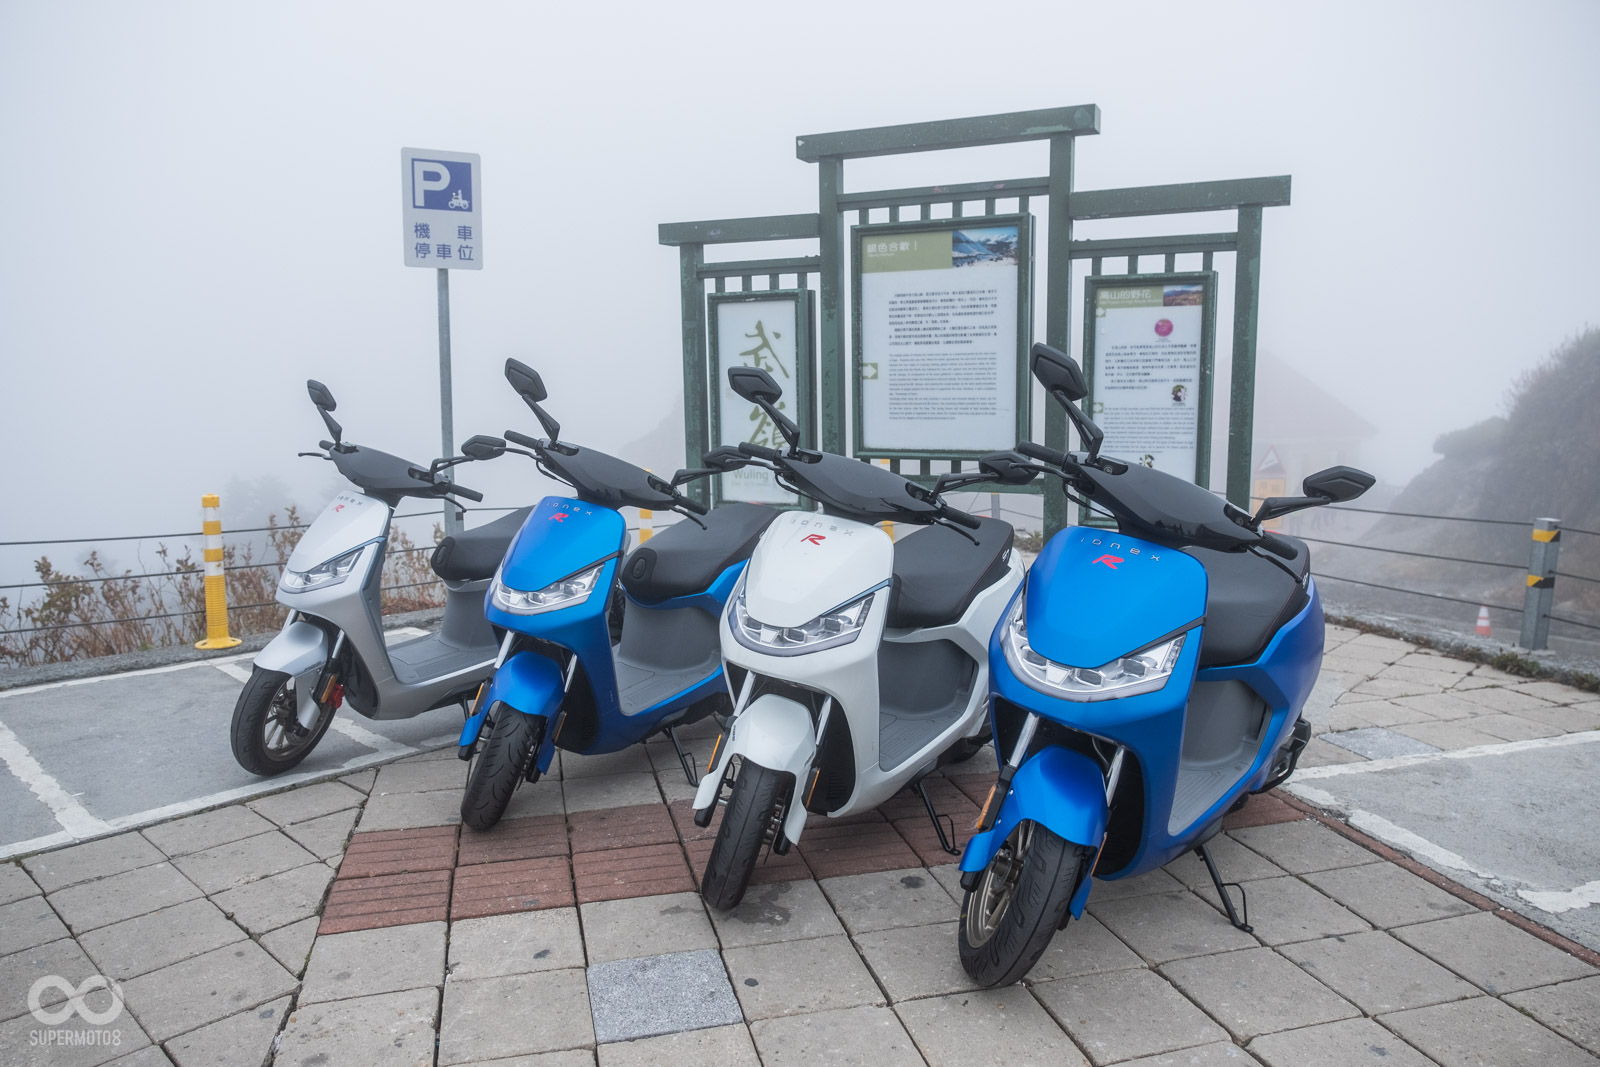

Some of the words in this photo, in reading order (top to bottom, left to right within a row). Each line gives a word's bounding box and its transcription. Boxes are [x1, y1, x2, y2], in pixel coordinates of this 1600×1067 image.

[414, 160, 451, 207] P
[414, 242, 474, 261] 停車位
[1099, 288, 1152, 300] 高山的野花
[733, 469, 769, 483] Wuling
[546, 502, 592, 516] ionex
[548, 512, 569, 523] R
[800, 533, 826, 546] R
[1080, 537, 1160, 562] ionex
[1092, 554, 1125, 570] R
